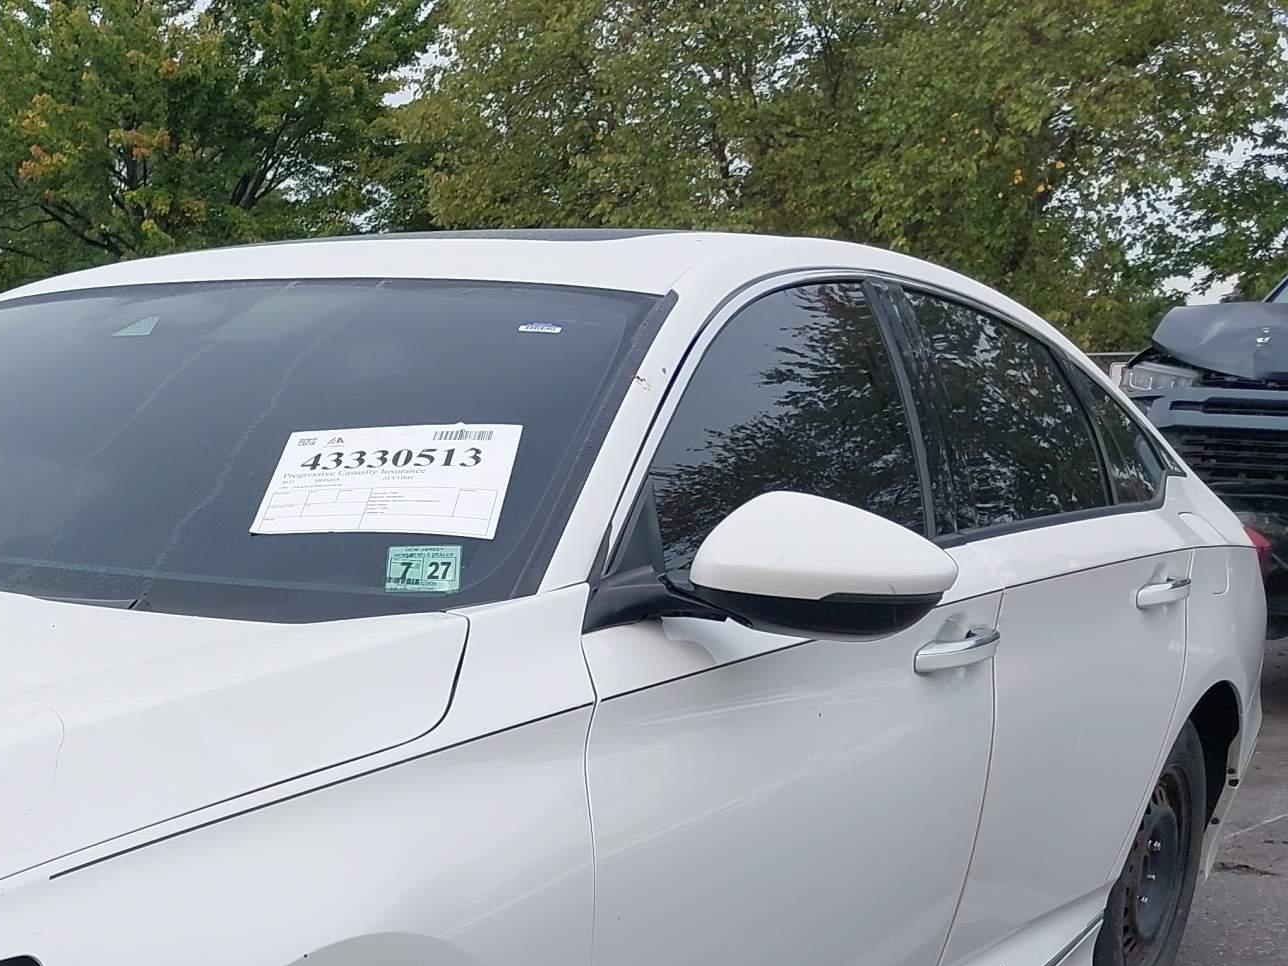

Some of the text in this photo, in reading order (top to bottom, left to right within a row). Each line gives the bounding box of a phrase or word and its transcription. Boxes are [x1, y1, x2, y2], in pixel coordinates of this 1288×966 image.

[301, 447, 482, 471] 43330513
[283, 471, 336, 479] Progressive
[338, 469, 379, 477] Casualty
[400, 561, 452, 580] 7 27
